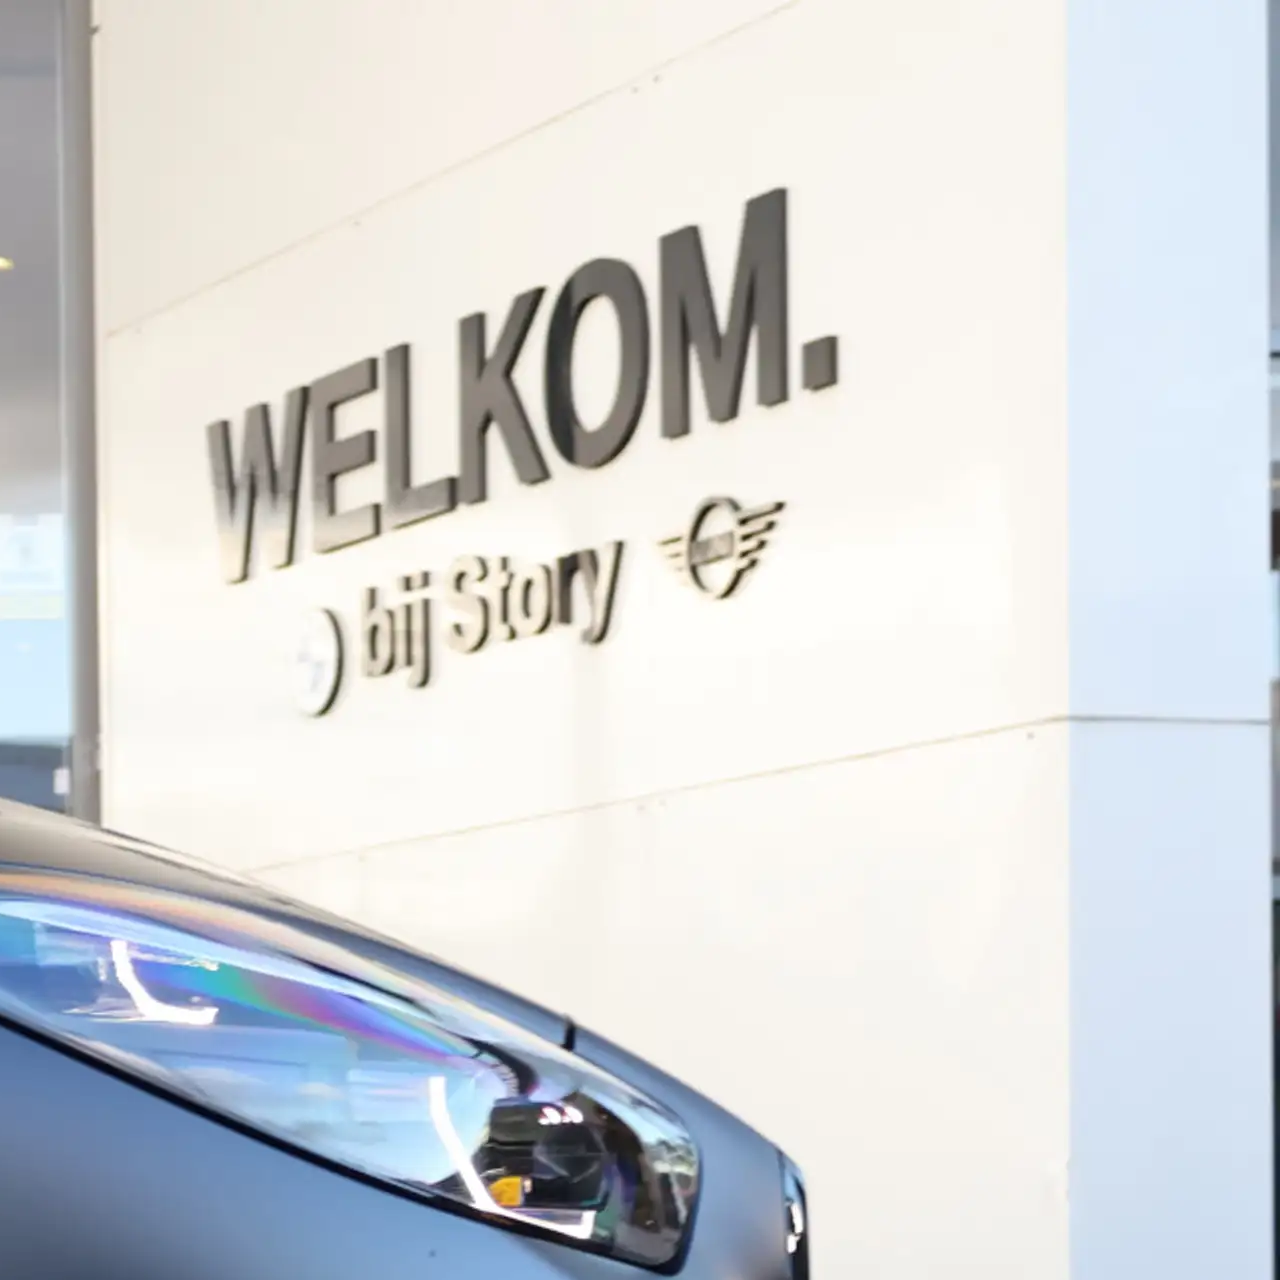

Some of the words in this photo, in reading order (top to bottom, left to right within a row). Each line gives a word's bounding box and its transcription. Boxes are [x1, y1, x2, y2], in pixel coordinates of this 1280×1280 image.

[206, 187, 839, 585] WELKOM.
[360, 570, 433, 688] bij
[447, 540, 626, 654] Story
